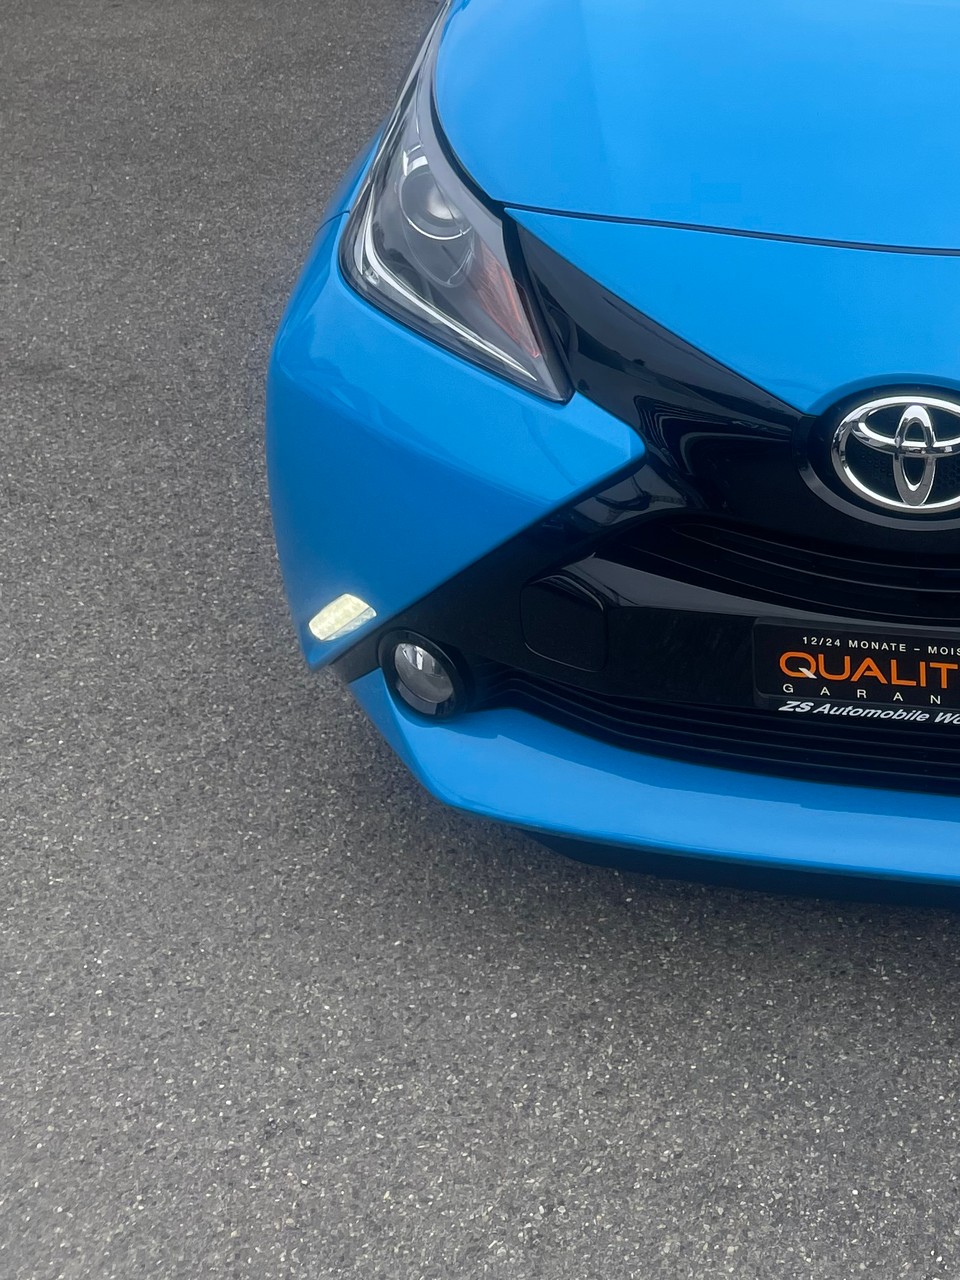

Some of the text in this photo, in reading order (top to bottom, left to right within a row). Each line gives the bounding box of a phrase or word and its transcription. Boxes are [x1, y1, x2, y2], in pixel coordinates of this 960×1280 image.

[802, 636, 841, 647] 12/24
[848, 639, 907, 652] MONATE
[778, 700, 814, 713] ZS
[812, 703, 930, 722] Automobile
